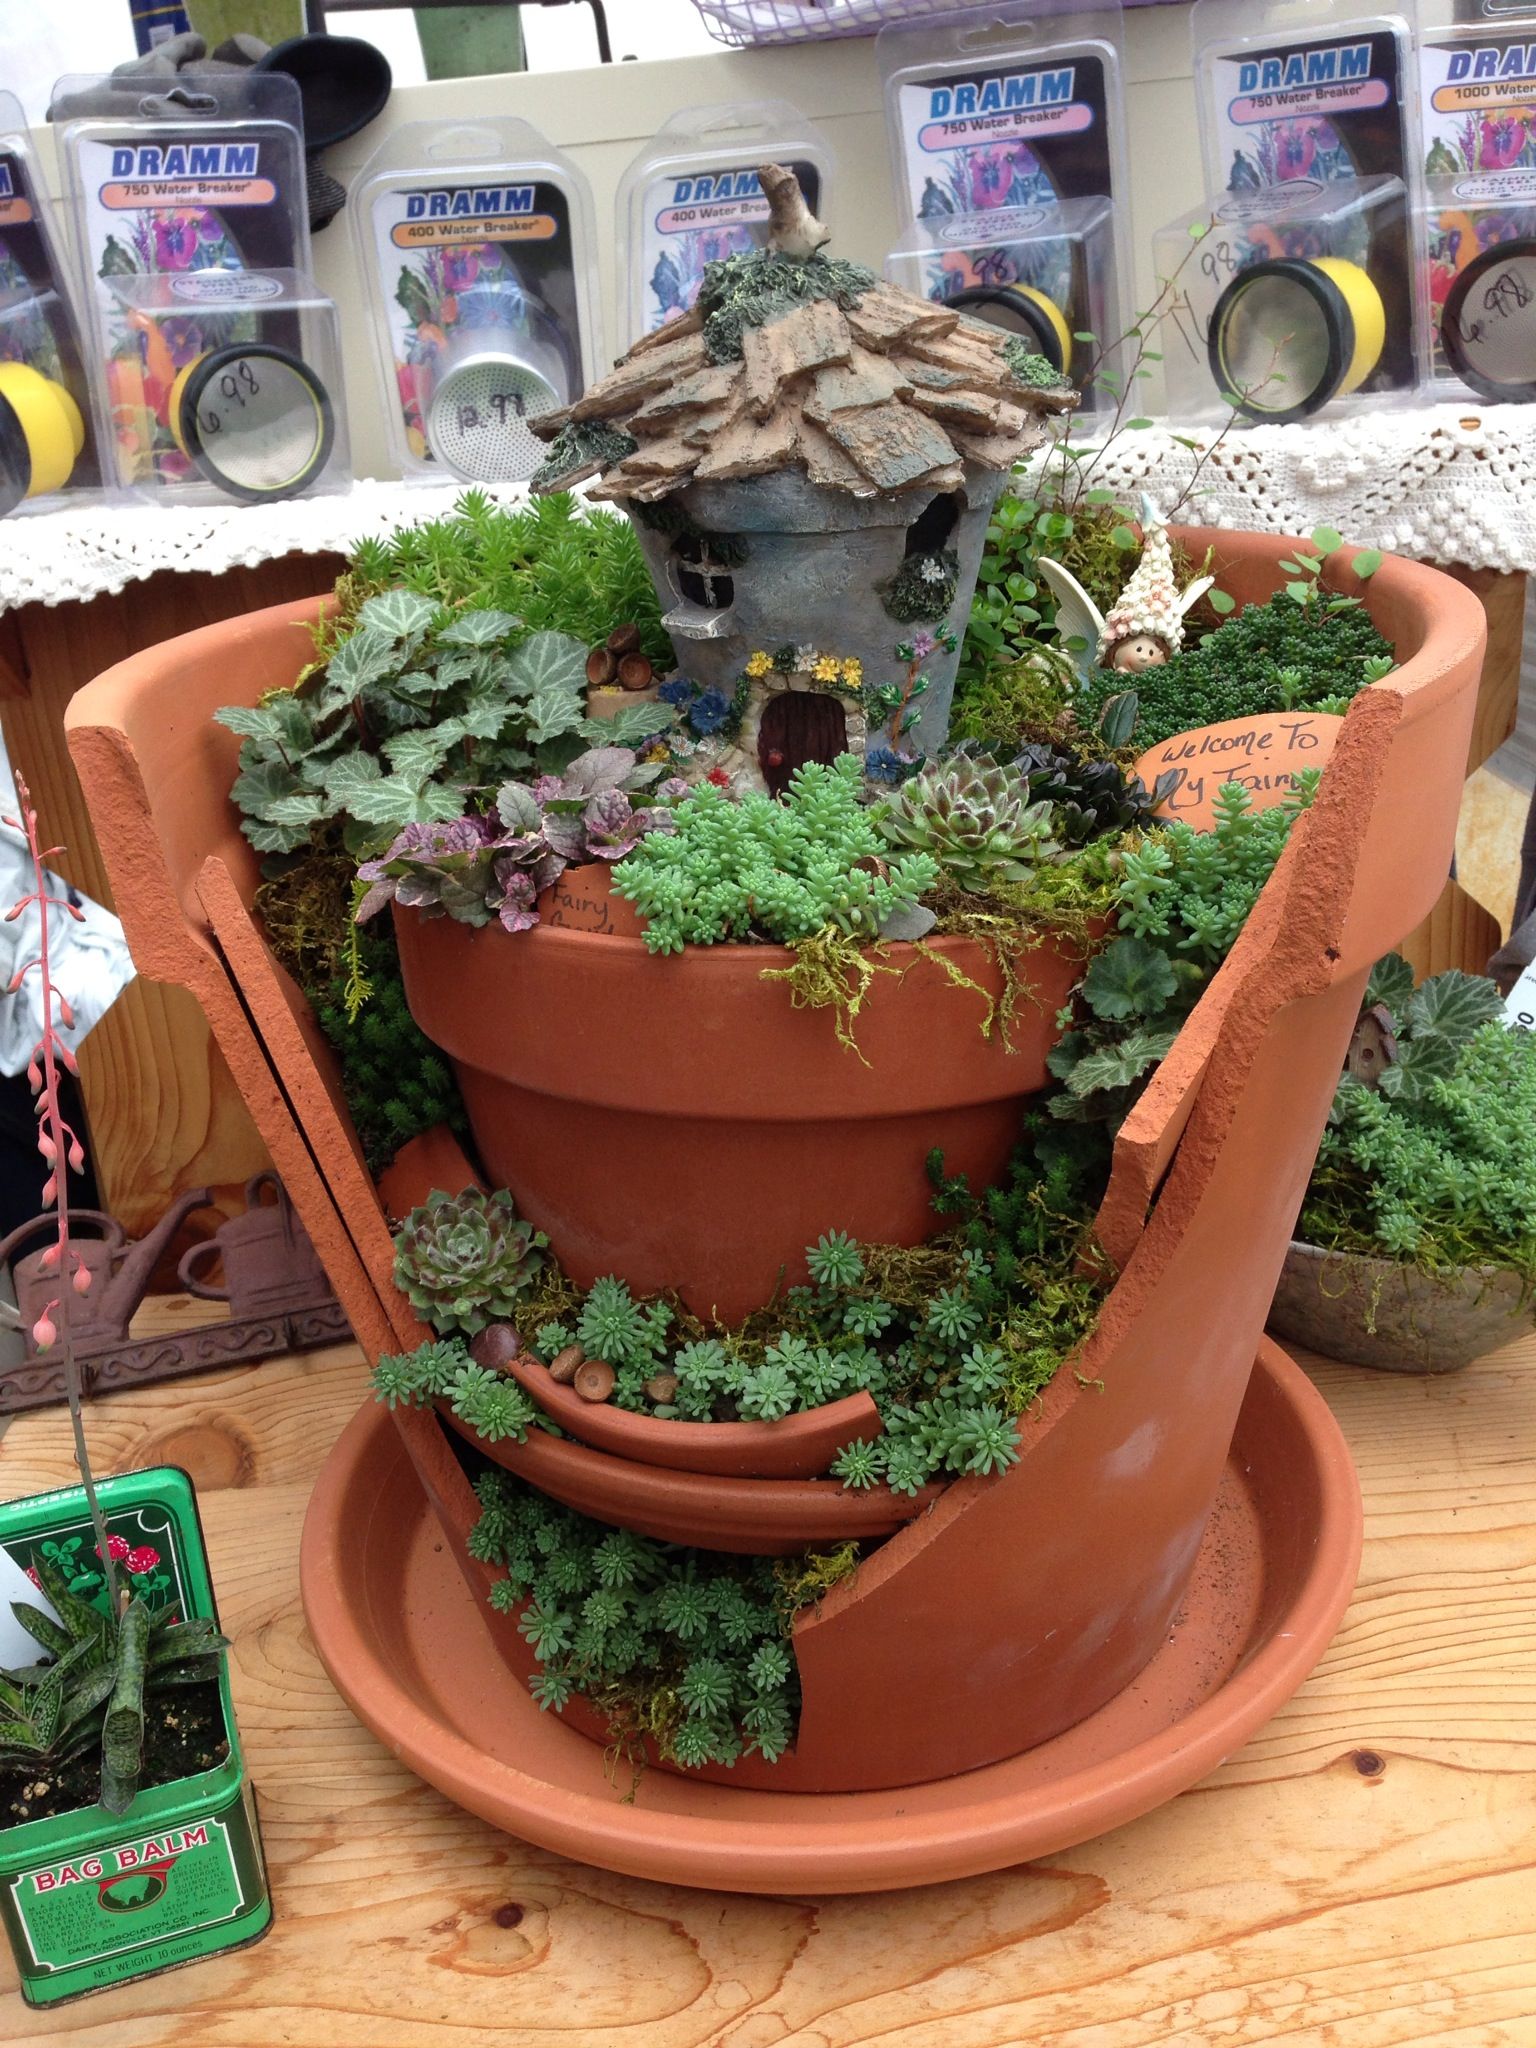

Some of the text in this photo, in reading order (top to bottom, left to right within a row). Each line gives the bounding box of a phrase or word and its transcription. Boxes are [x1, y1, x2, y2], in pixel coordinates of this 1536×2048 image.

[1239, 45, 1371, 92] DRAMM
[931, 69, 1074, 118] DRAMM
[1250, 97, 1273, 109] 750
[1276, 92, 1312, 105] Water
[1455, 83, 1536, 98] 1000 Water
[942, 122, 967, 135] 750
[971, 118, 1010, 131] Water
[112, 145, 257, 177] DRAMM
[124, 184, 149, 196] 750
[154, 183, 193, 195] Water
[673, 172, 766, 203] DRAM
[407, 188, 532, 218] DRAMM
[672, 203, 770, 222] 400 Water Brea
[408, 226, 434, 238] 400
[438, 224, 480, 236] Water
[1161, 719, 1319, 762] Welcome To
[551, 882, 609, 930] Fairy
[35, 1825, 209, 1894] BAG BALM
[67, 1941, 97, 1955] DAIRY
[101, 1920, 169, 1945] ASSOCIATION
[93, 1965, 113, 1979] NET
[115, 1953, 153, 1972] WEIGHT
